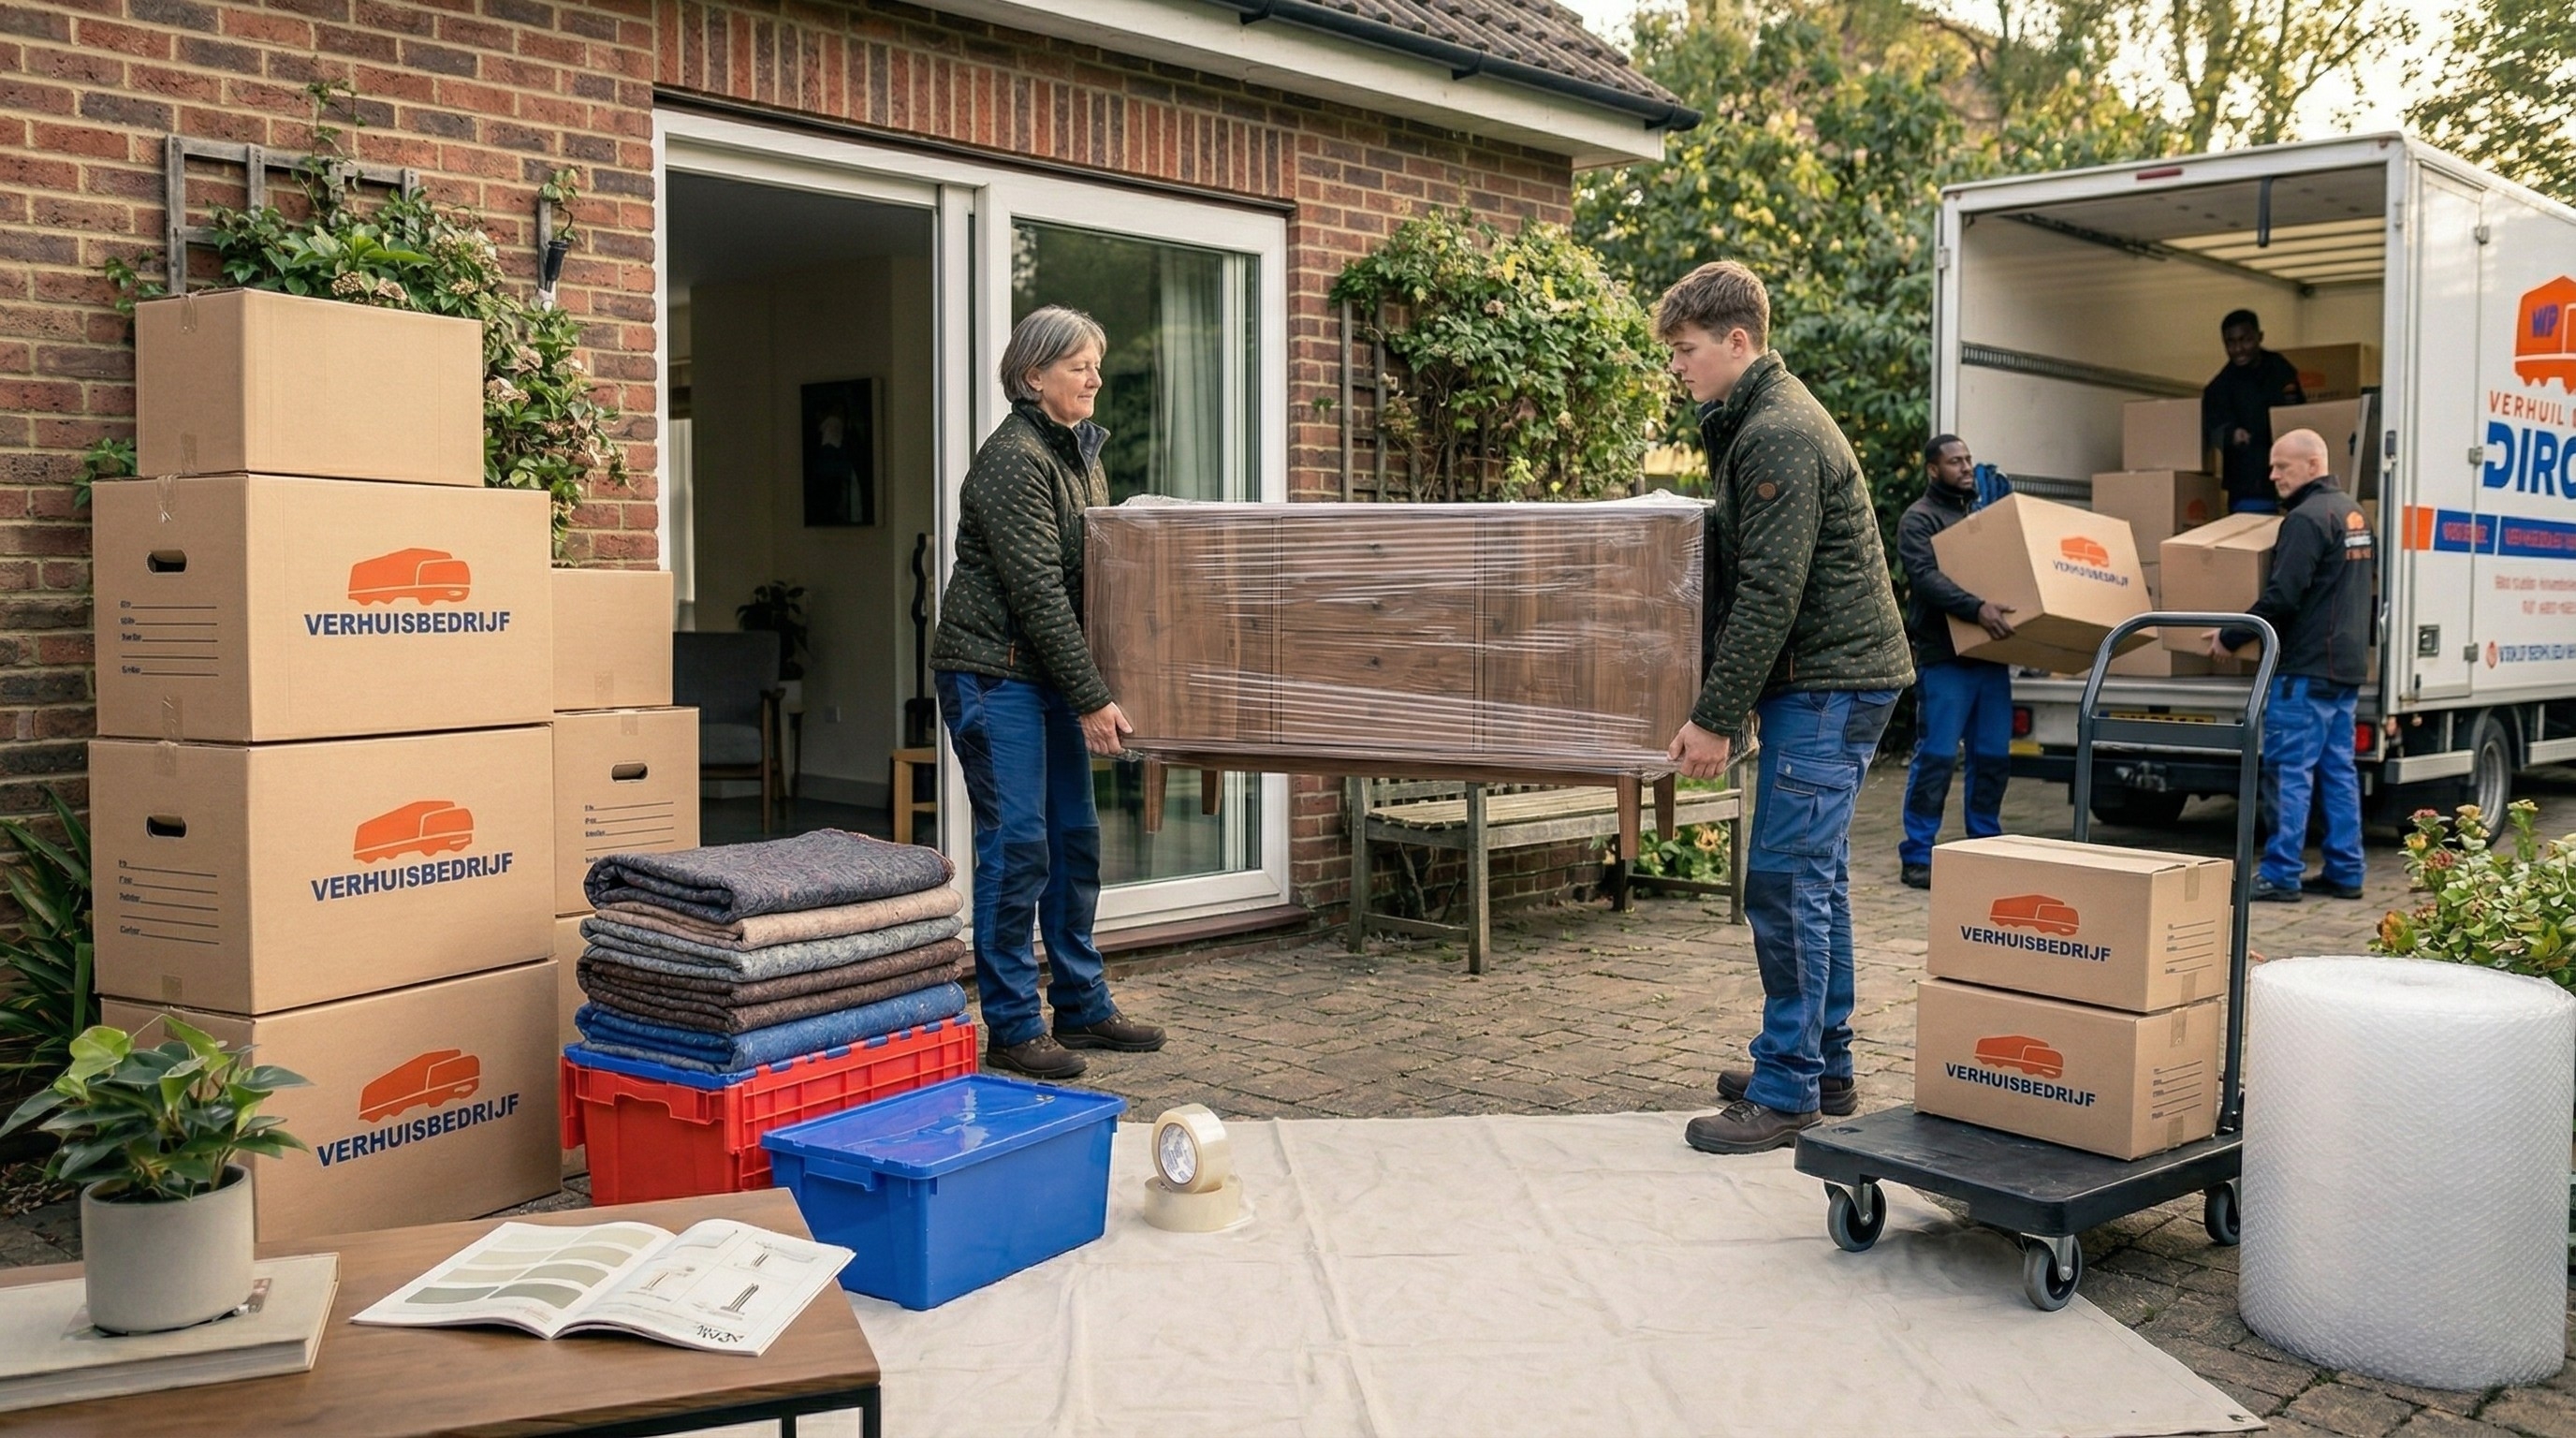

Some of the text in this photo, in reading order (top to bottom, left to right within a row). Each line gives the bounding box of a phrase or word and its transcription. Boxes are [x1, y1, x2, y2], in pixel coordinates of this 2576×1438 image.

[2489, 389, 2564, 425] VERHUIL
[304, 611, 511, 637] VERHUISBEDRIJF
[311, 852, 513, 902] VERHUISBEDRIJF
[1960, 925, 2112, 962] VERHUISBEDRIJF
[1945, 1063, 2096, 1108] VERHUISBEDRIJF
[316, 1093, 520, 1167] VERHUISBEDRIJF
